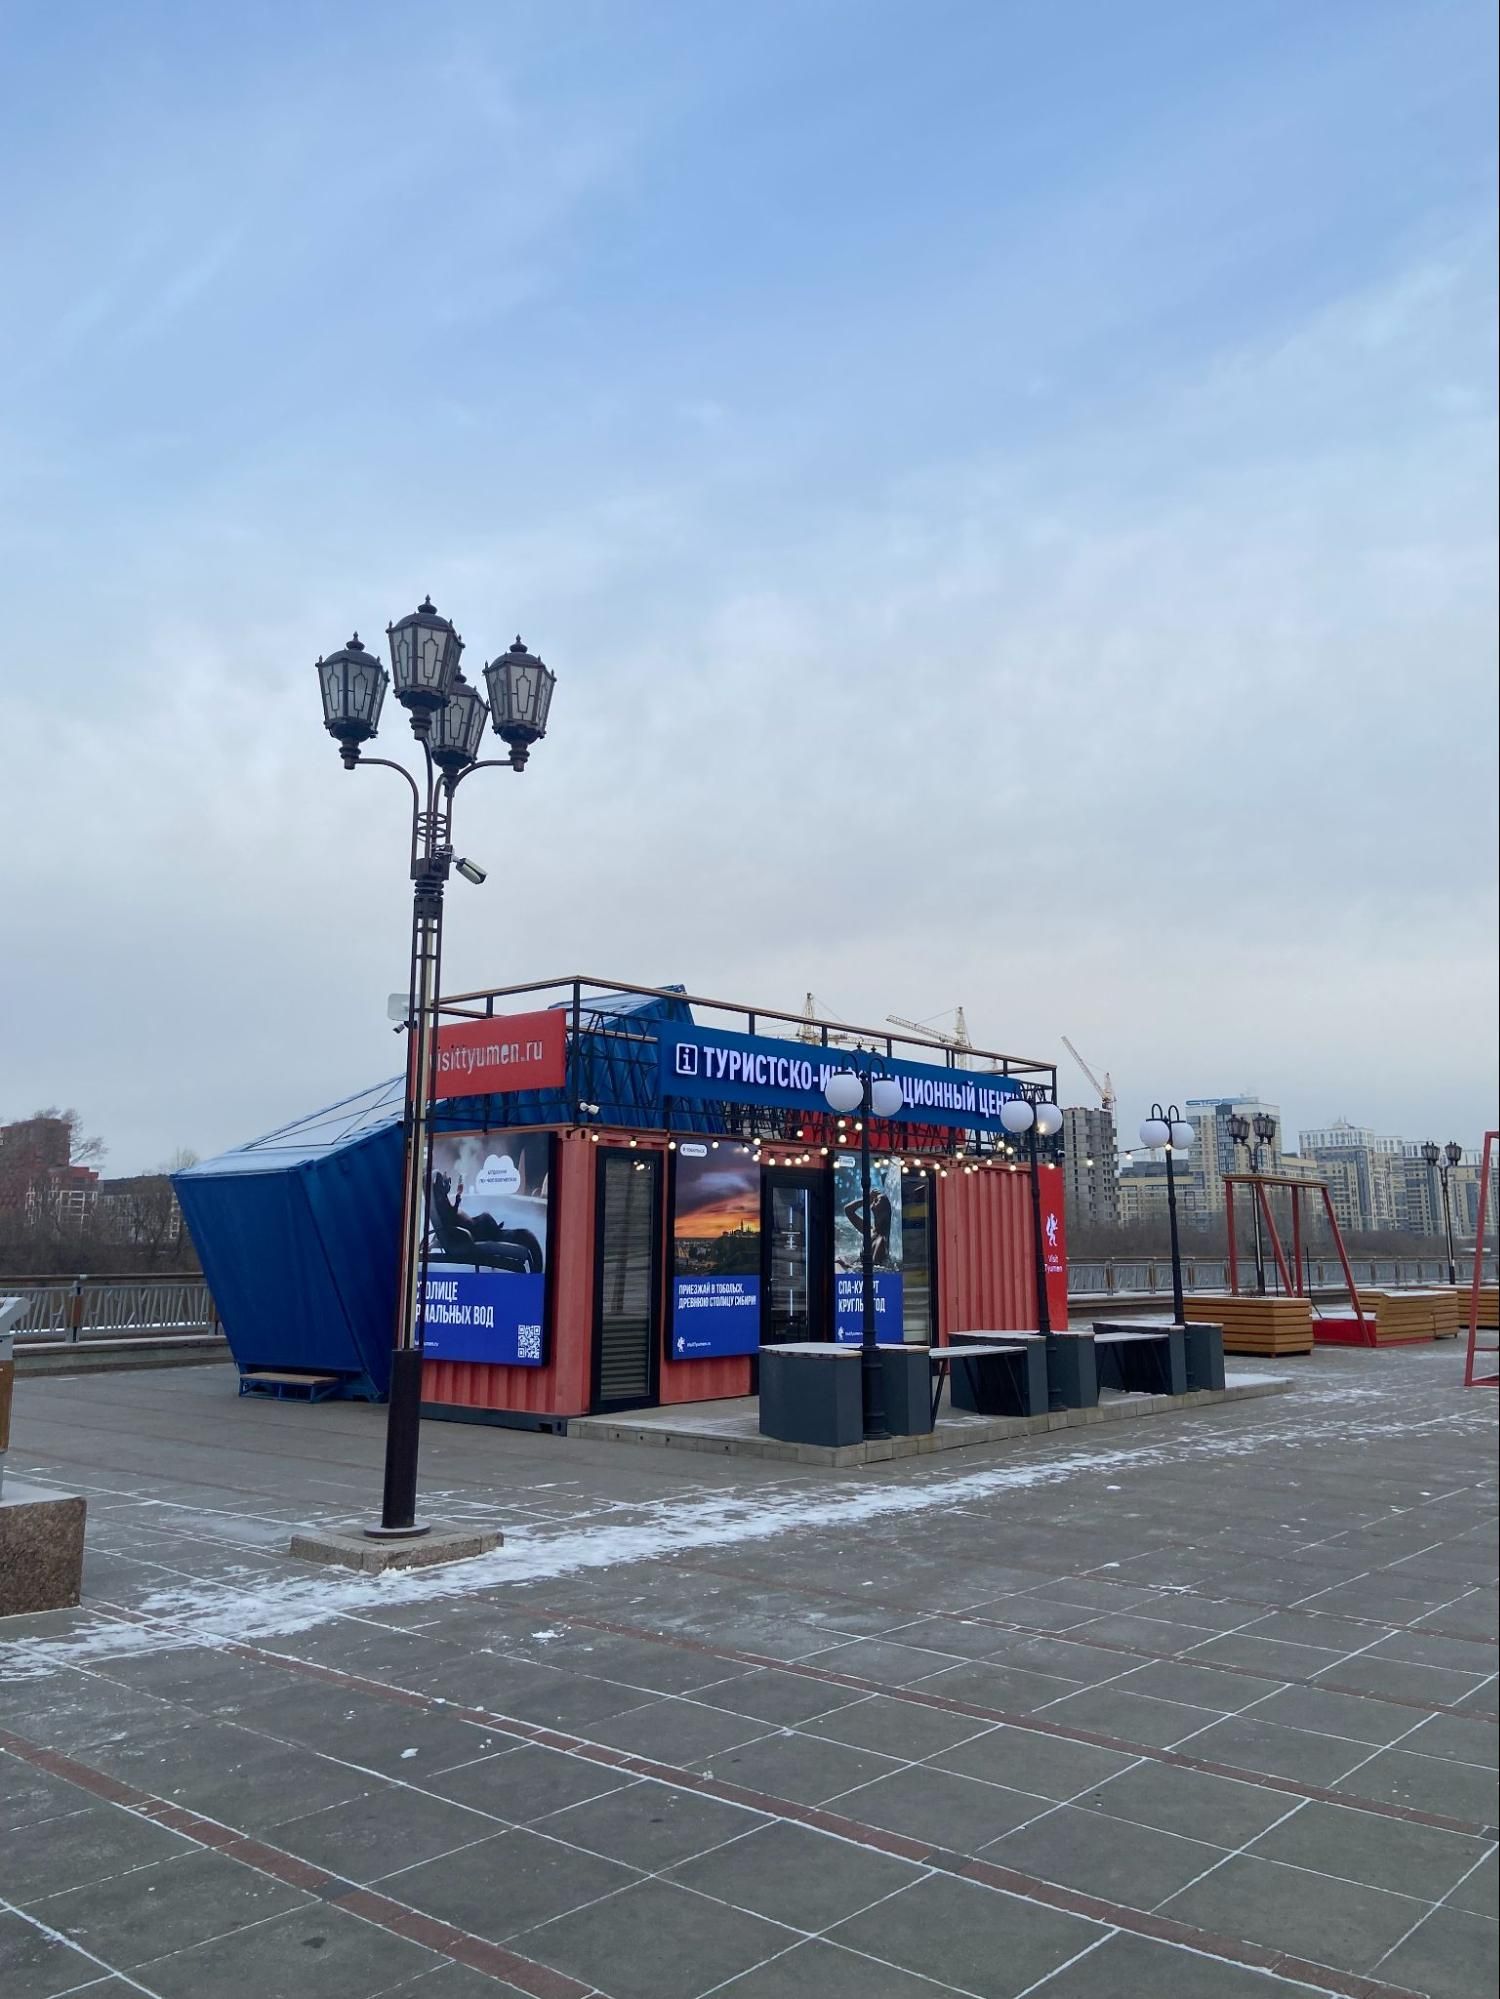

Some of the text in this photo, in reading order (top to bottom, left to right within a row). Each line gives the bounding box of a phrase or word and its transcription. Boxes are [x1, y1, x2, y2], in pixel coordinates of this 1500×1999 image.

[978, 1088, 1019, 1118] ЦЕН
[416, 1280, 459, 1302] СОЛИЦЕ
[838, 1280, 880, 1295] СПА-КУТ
[873, 1297, 886, 1313] ОД
[473, 1305, 494, 1328] ВОД
